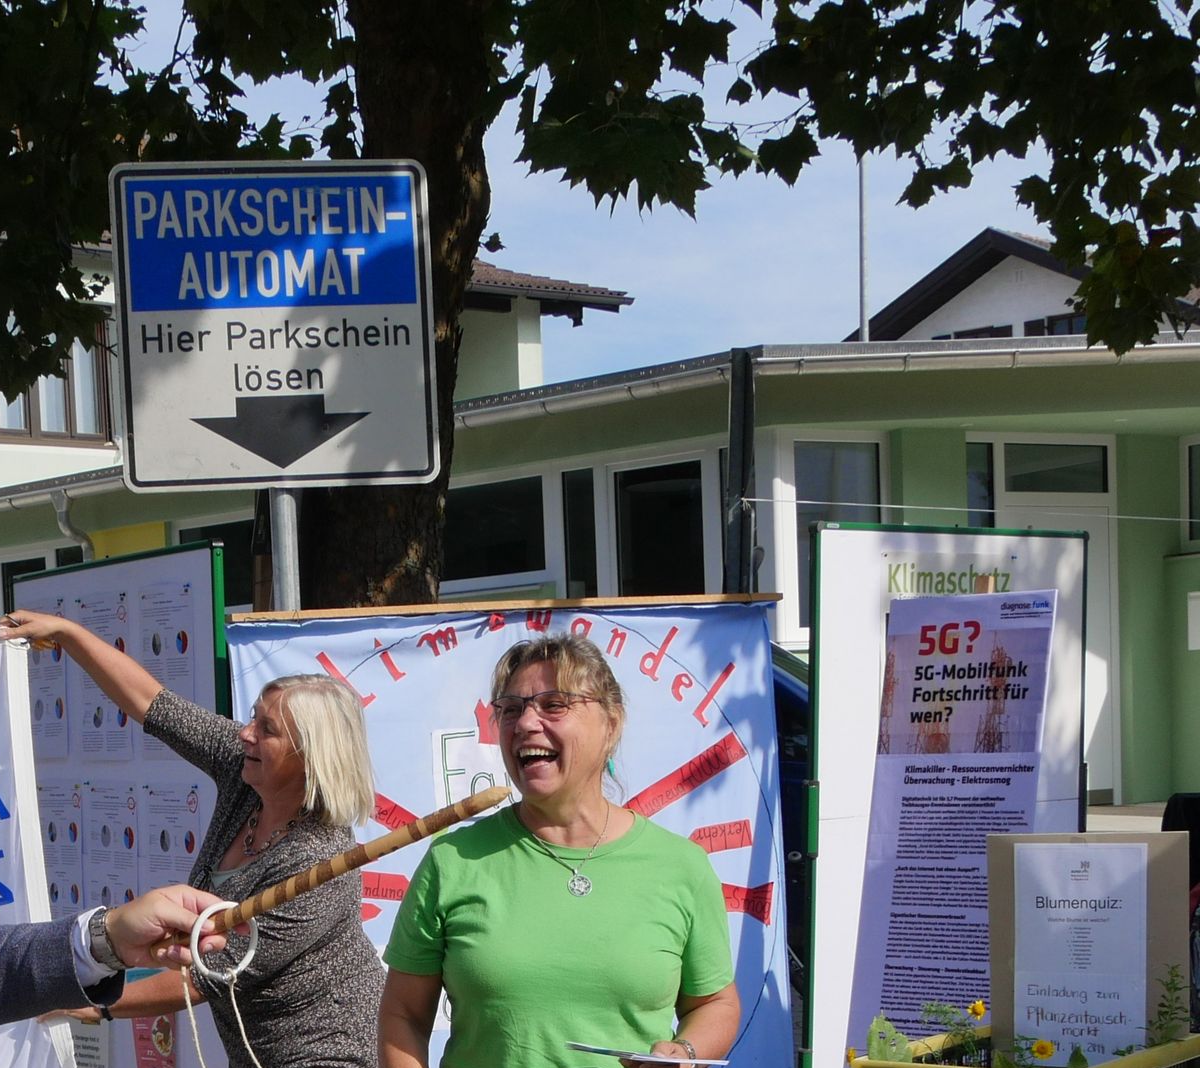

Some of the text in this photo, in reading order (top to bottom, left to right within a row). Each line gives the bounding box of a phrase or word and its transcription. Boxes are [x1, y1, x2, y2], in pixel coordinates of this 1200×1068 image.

[133, 186, 406, 240] PARKSCHEIN-
[178, 247, 365, 300] AUTOMAT
[141, 317, 411, 354] Hier Parkschein
[234, 363, 324, 392] lösen
[887, 563, 1011, 594] Klimaschtz
[918, 620, 981, 656] 5G?
[914, 660, 1028, 681] 5G-Mobilfunk
[912, 683, 1029, 703] Fortschritt für
[910, 706, 953, 723] wen?
[905, 765, 946, 774] Klimakiller
[952, 763, 1034, 773] Ressourcenvernichter
[904, 776, 955, 786] Überwachung
[962, 776, 1011, 786] Elektrosmog
[695, 819, 752, 849] Verkehr
[1035, 896, 1123, 912] Blumenquiz:
[1026, 983, 1120, 1004] Einladung zum
[1062, 1026, 1100, 1038] markt
